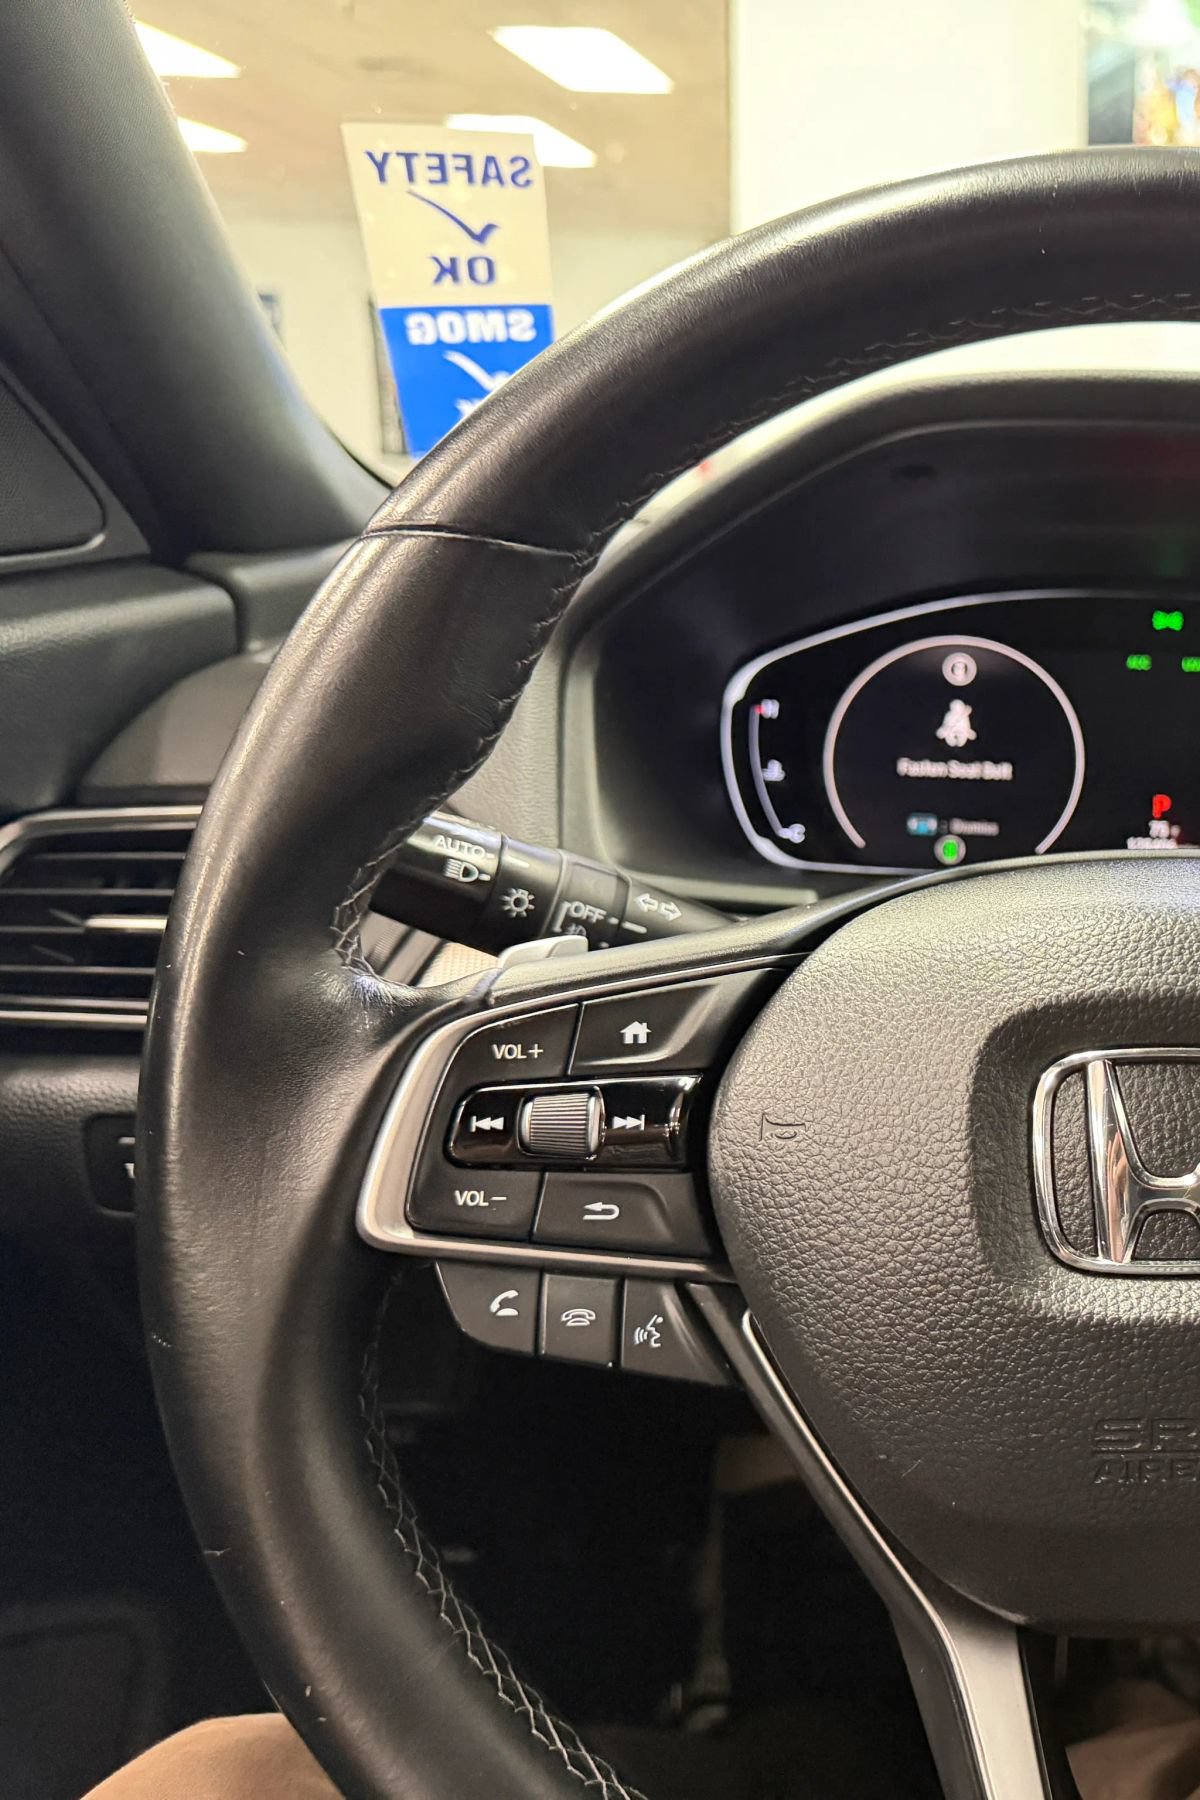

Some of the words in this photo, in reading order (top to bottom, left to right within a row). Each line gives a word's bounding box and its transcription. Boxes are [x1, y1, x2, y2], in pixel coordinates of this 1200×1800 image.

[1152, 793, 1172, 818] P
[434, 834, 486, 858] AUTO
[567, 901, 607, 923] OFF
[491, 1043, 544, 1060] VOL+
